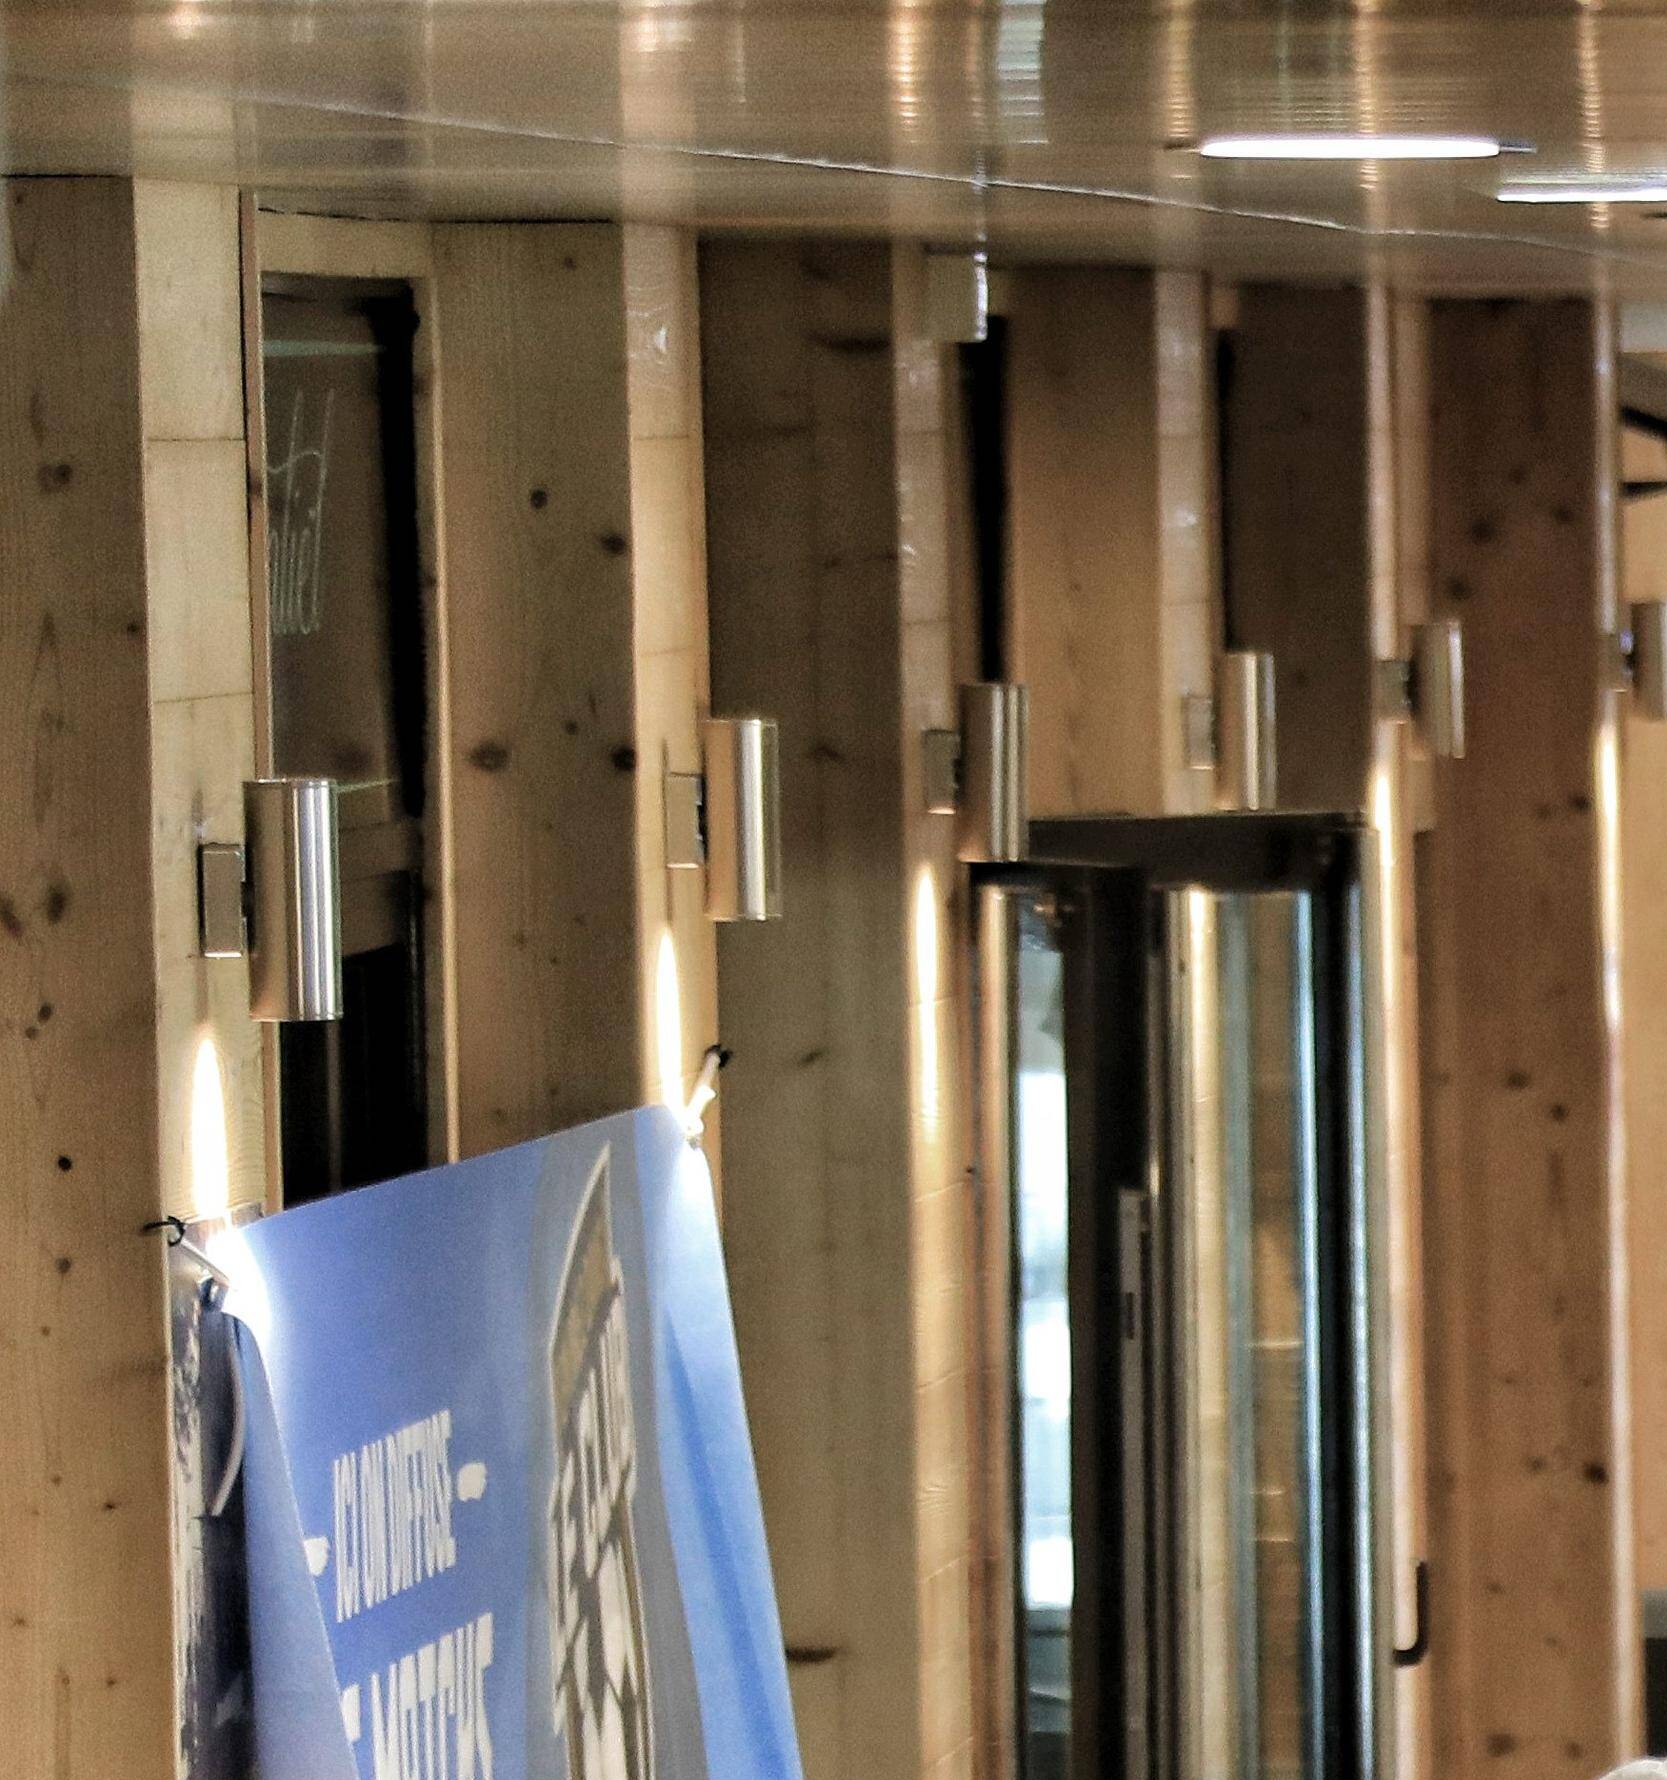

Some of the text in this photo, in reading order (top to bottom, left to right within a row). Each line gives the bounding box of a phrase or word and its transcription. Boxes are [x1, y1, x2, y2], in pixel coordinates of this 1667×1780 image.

[334, 1452, 361, 1624] ICI
[360, 1438, 389, 1609] ON
[384, 1408, 457, 1597] DIFFUSE
